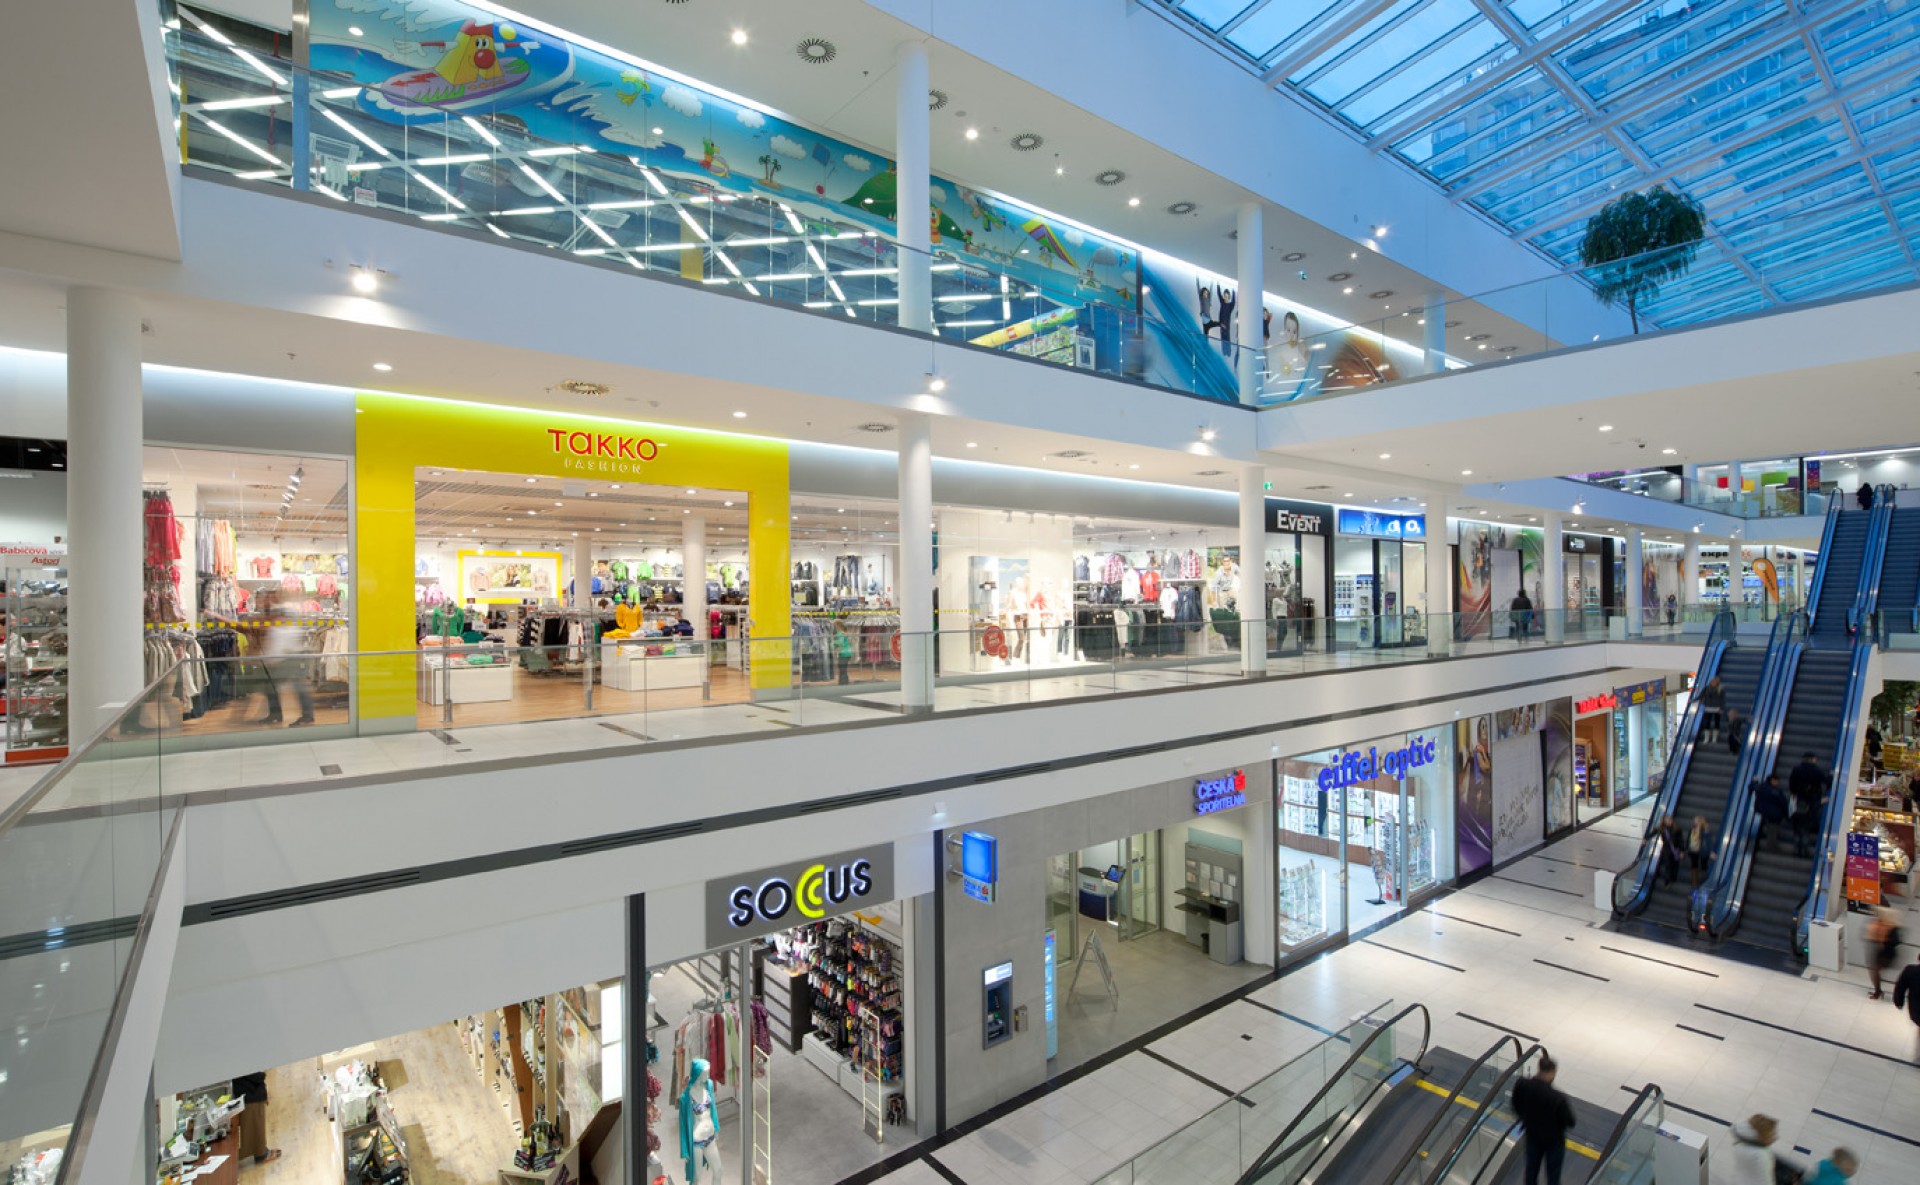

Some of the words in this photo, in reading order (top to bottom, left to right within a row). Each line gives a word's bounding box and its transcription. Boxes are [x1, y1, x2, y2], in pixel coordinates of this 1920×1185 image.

[564, 459, 641, 473] FASHION
[1318, 746, 1379, 792] eiffel
[1384, 735, 1436, 781] optic
[1197, 774, 1235, 799] ČESKÁ
